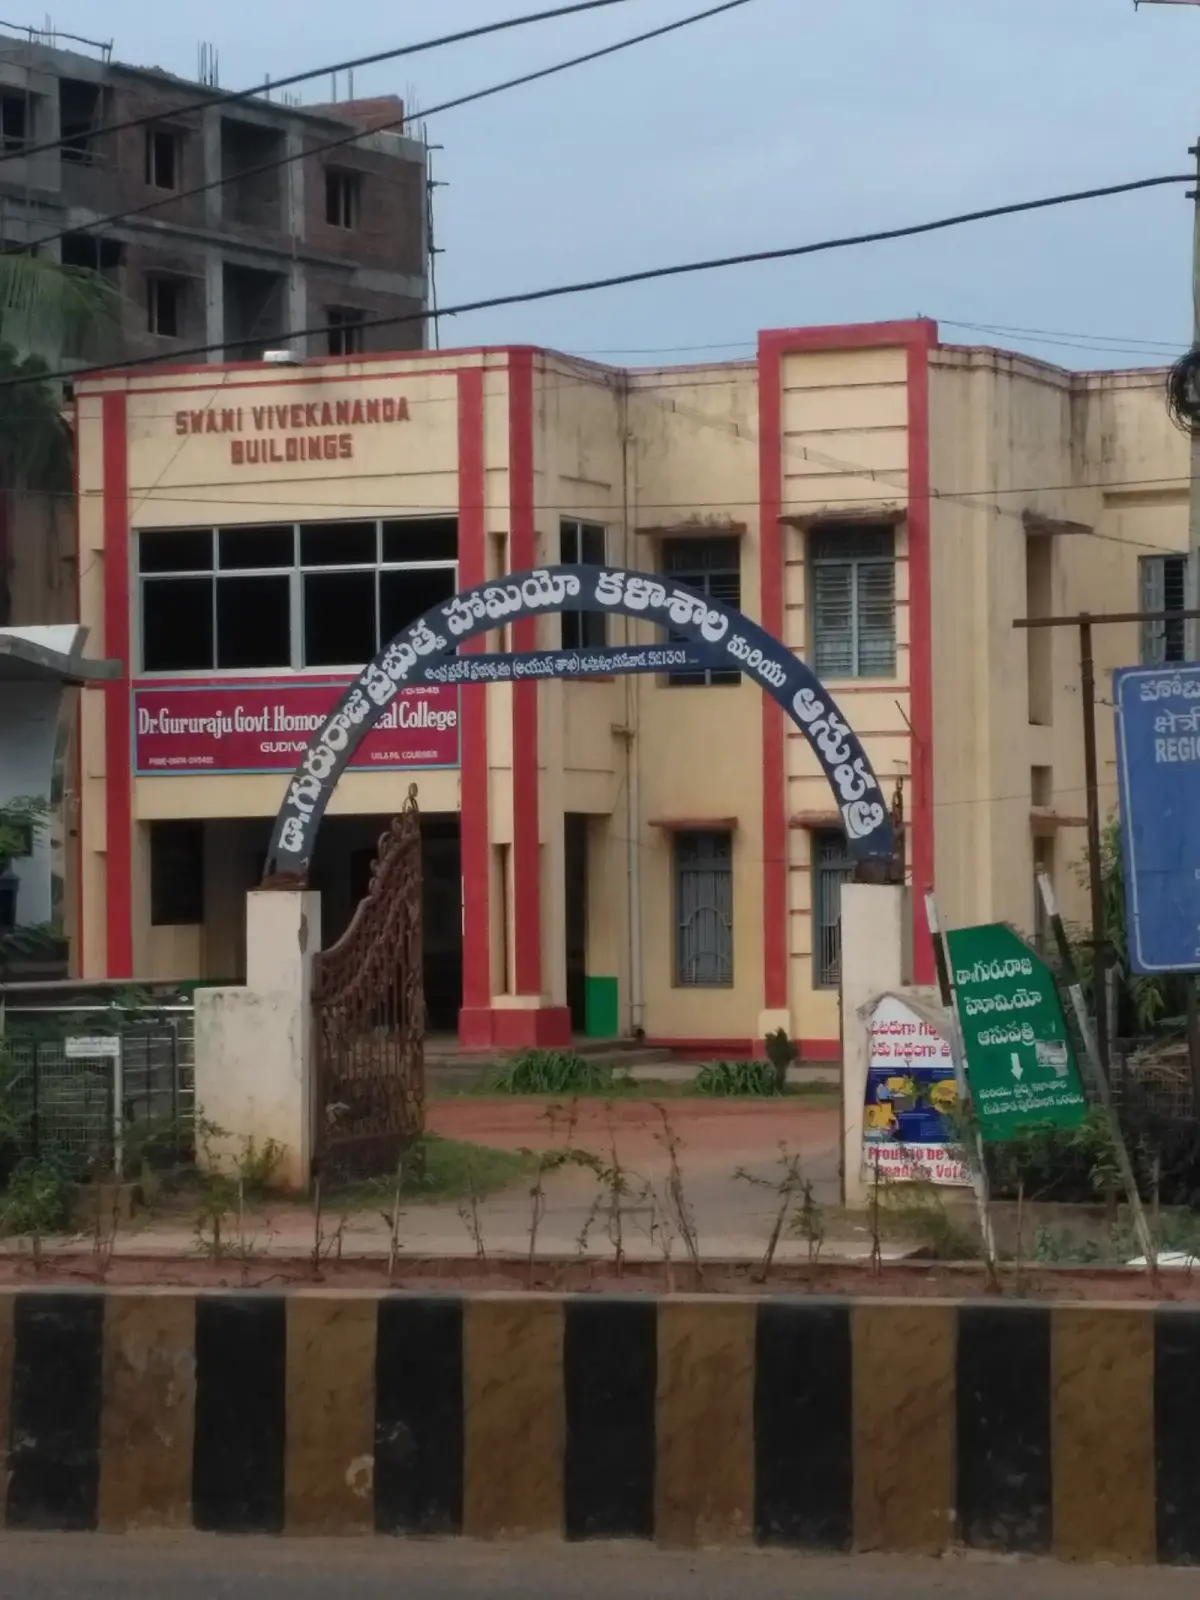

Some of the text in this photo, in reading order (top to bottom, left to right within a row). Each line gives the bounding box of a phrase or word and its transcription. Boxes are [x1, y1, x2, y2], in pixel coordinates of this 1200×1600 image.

[175, 396, 411, 435] SWAMI VIVEKANANDA
[230, 433, 353, 465] BUILDINGS
[399, 700, 457, 731] College
[595, 572, 729, 642] కళాశాల
[727, 634, 787, 687] మరియు
[792, 688, 884, 838] ఆసుపత్రి
